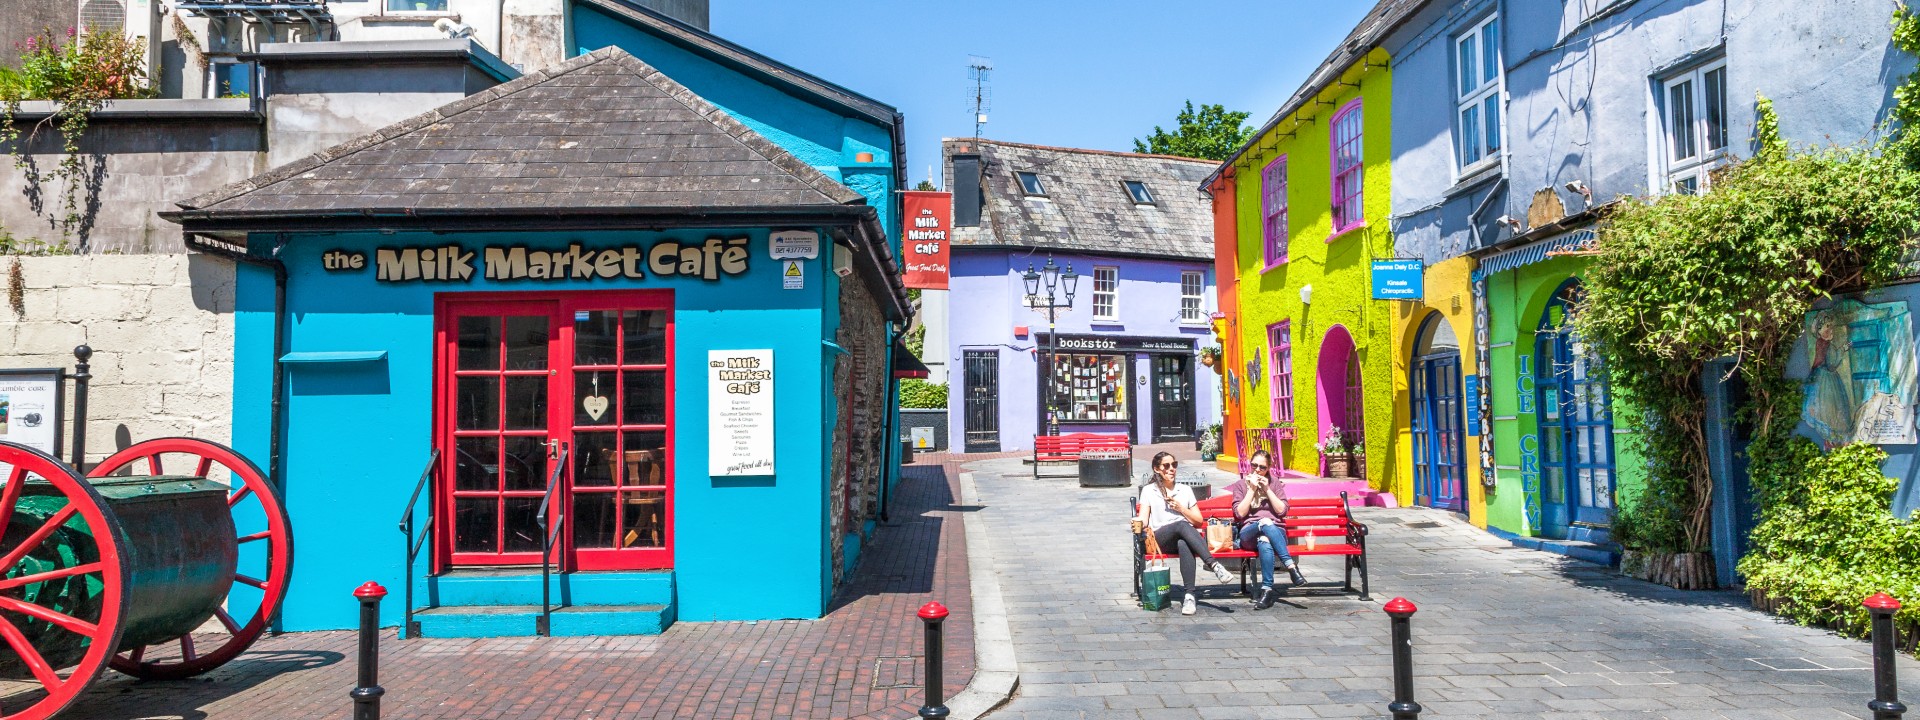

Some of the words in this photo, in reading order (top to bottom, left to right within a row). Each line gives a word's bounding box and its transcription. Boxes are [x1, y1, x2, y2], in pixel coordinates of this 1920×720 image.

[908, 230, 946, 240] Market
[915, 216, 939, 228] Milk
[323, 251, 365, 269] the
[376, 246, 475, 281] Milk
[485, 244, 643, 280] Market
[649, 238, 749, 280] Café
[1059, 337, 1117, 349] bookstór
[1475, 280, 1489, 411] SMOOTHIE
[720, 369, 771, 381] Market
[728, 357, 760, 368] Milk
[1516, 355, 1535, 414] ICE
[1480, 417, 1491, 468] BAR
[1519, 434, 1542, 531] CREAM
